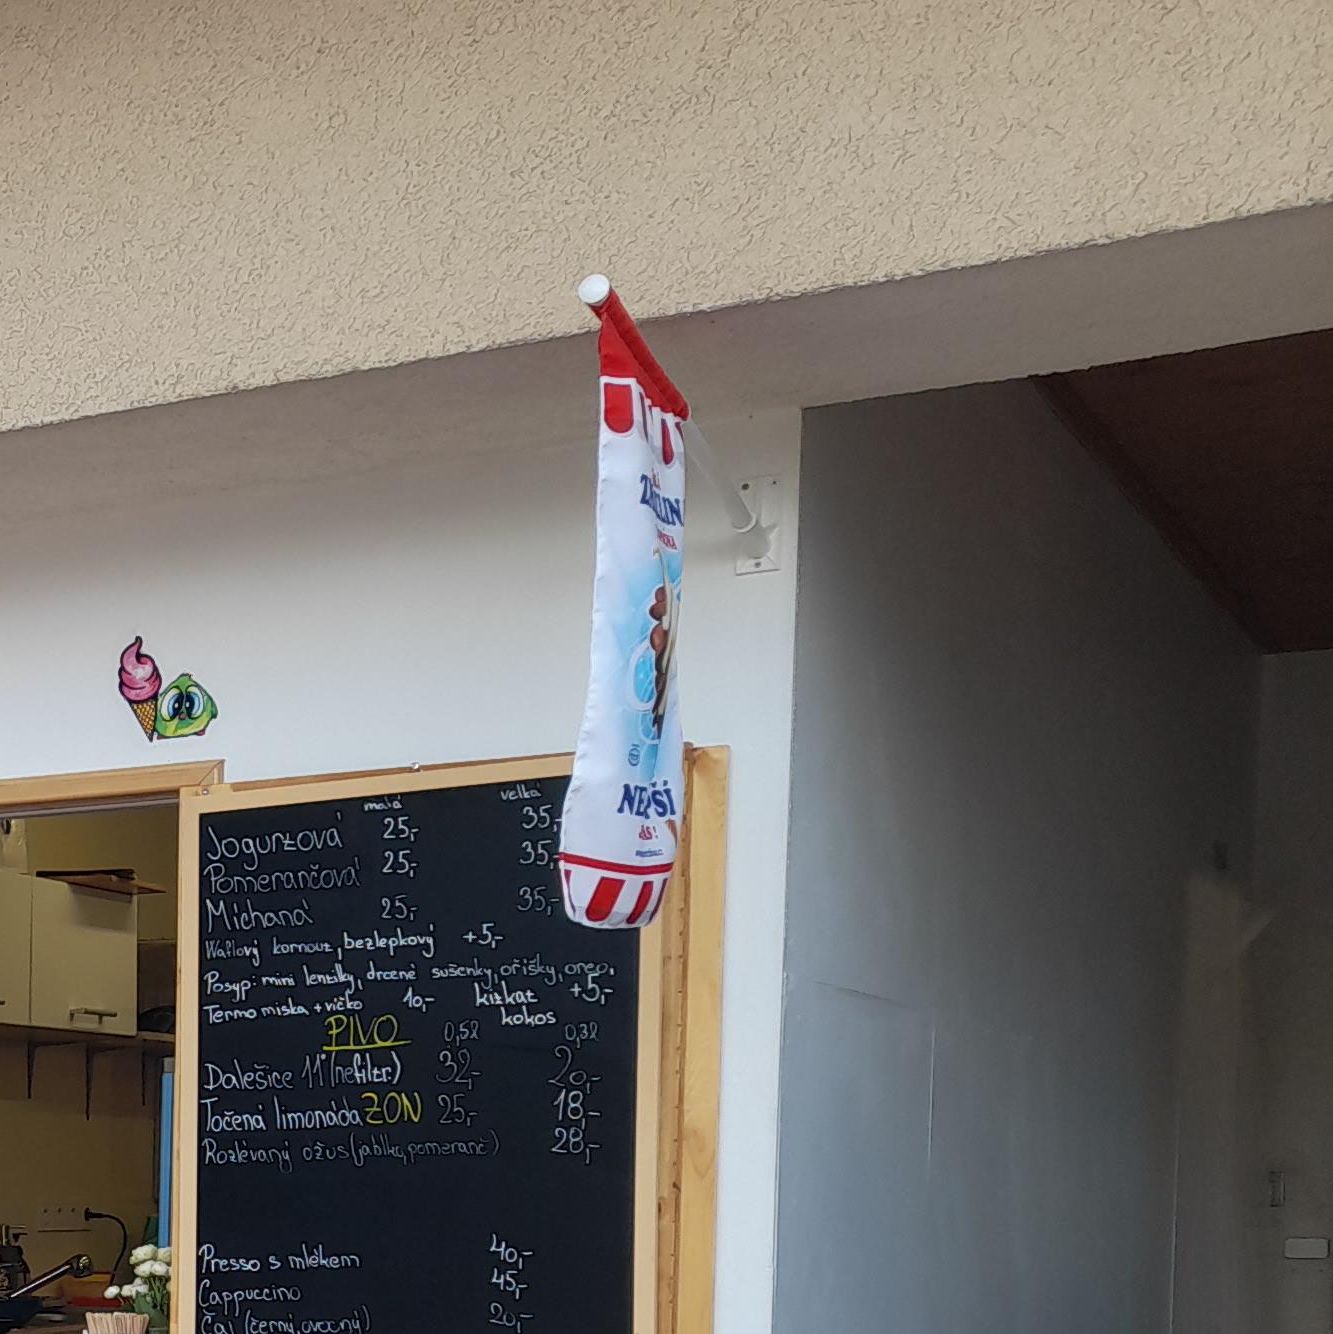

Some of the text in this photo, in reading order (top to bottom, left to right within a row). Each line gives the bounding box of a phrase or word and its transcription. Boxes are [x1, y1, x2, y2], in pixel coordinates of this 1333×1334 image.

[206, 804, 563, 870] Jogurtová 25,- 35,-
[203, 839, 560, 894] Pomerančová 25,- 35,-
[381, 894, 418, 921] 25,-
[517, 886, 560, 916] 35,-
[203, 970, 257, 1002] Posyp:
[261, 972, 296, 987] mini
[203, 1003, 257, 1025] Termo
[260, 996, 310, 1017] miska
[402, 986, 436, 1013] 10,-
[324, 1013, 399, 1047] PIVO
[500, 1004, 557, 1026] kokos
[202, 1058, 294, 1090] Dalešice
[435, 1048, 482, 1090] 32,-
[548, 1045, 602, 1094] 20,-
[200, 1088, 602, 1132] Točená limonáda ZON 25,- 18,-
[551, 1127, 601, 1165] 28,-
[198, 1233, 534, 1274] Presso s mlékem 40,-
[198, 1267, 529, 1317] Cappuccino 45,-
[489, 1302, 534, 1334] 20,-
